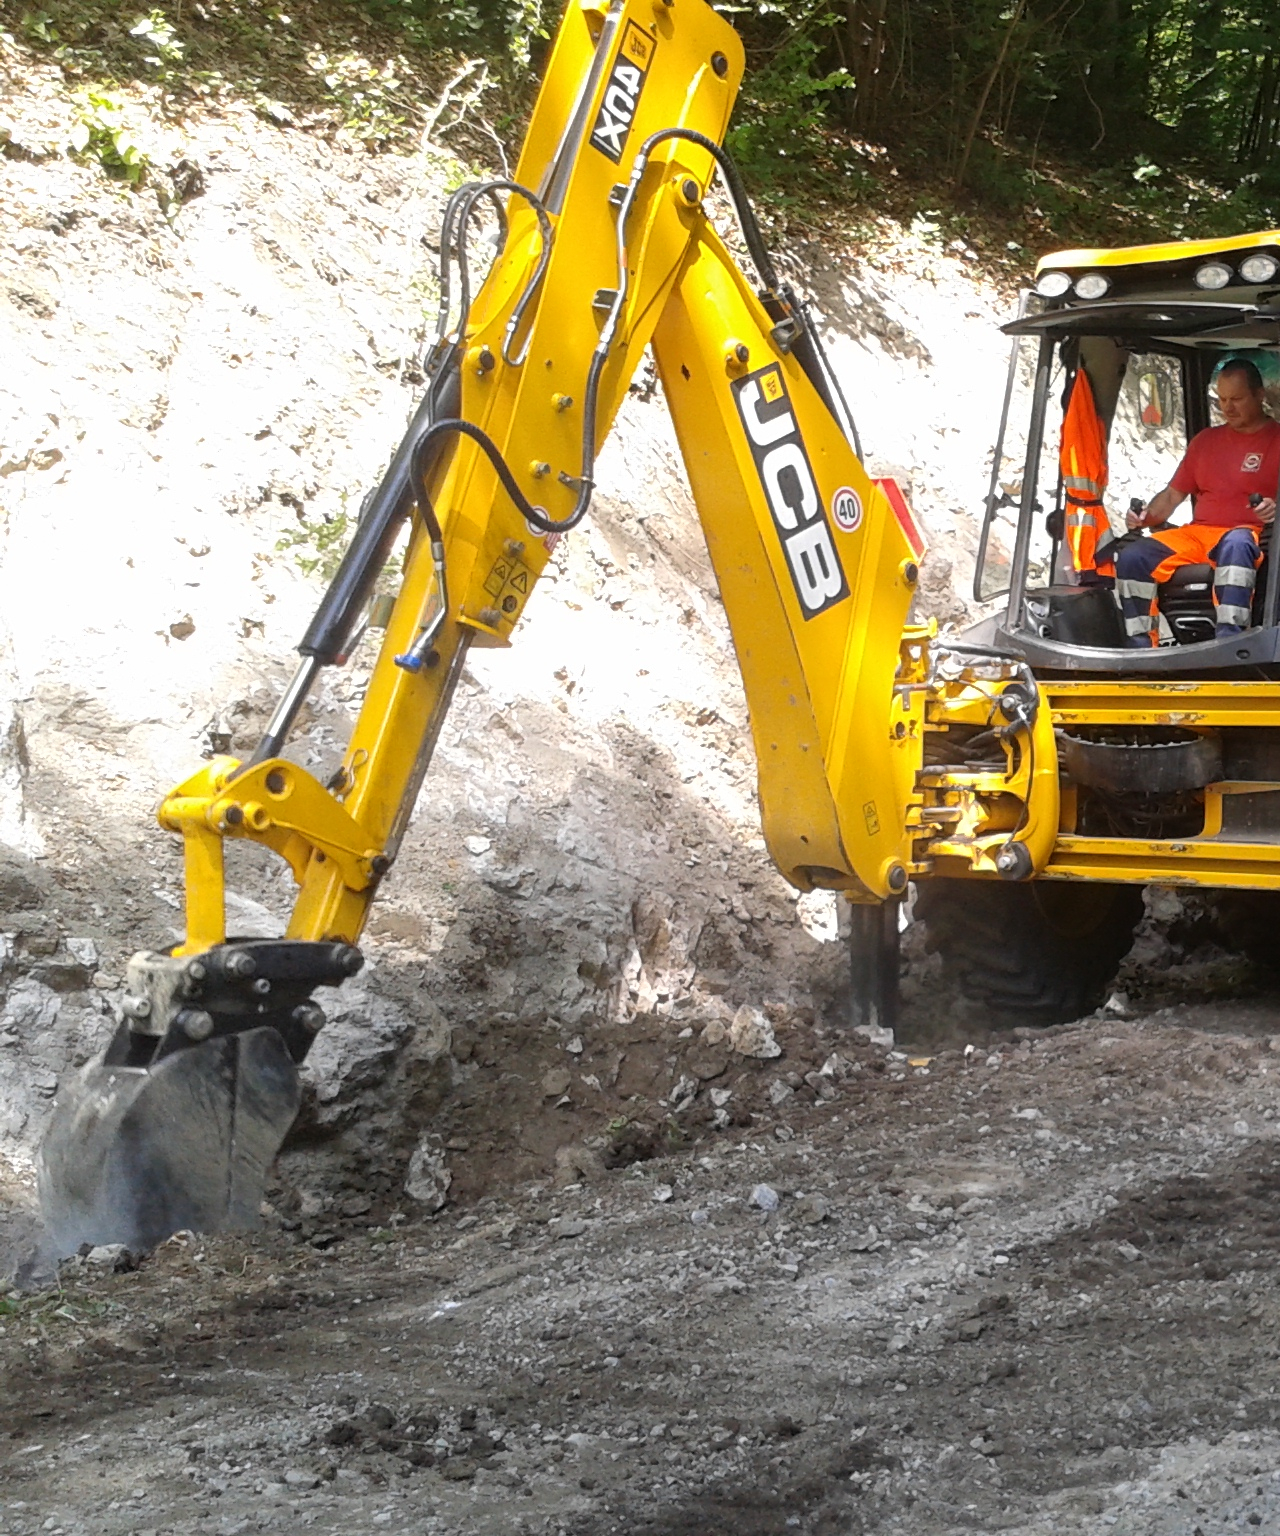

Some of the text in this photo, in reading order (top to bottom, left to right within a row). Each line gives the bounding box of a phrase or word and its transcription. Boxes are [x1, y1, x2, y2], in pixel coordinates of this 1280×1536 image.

[594, 66, 641, 153] 4CX
[739, 380, 842, 610] JCB
[839, 498, 856, 520] 40
